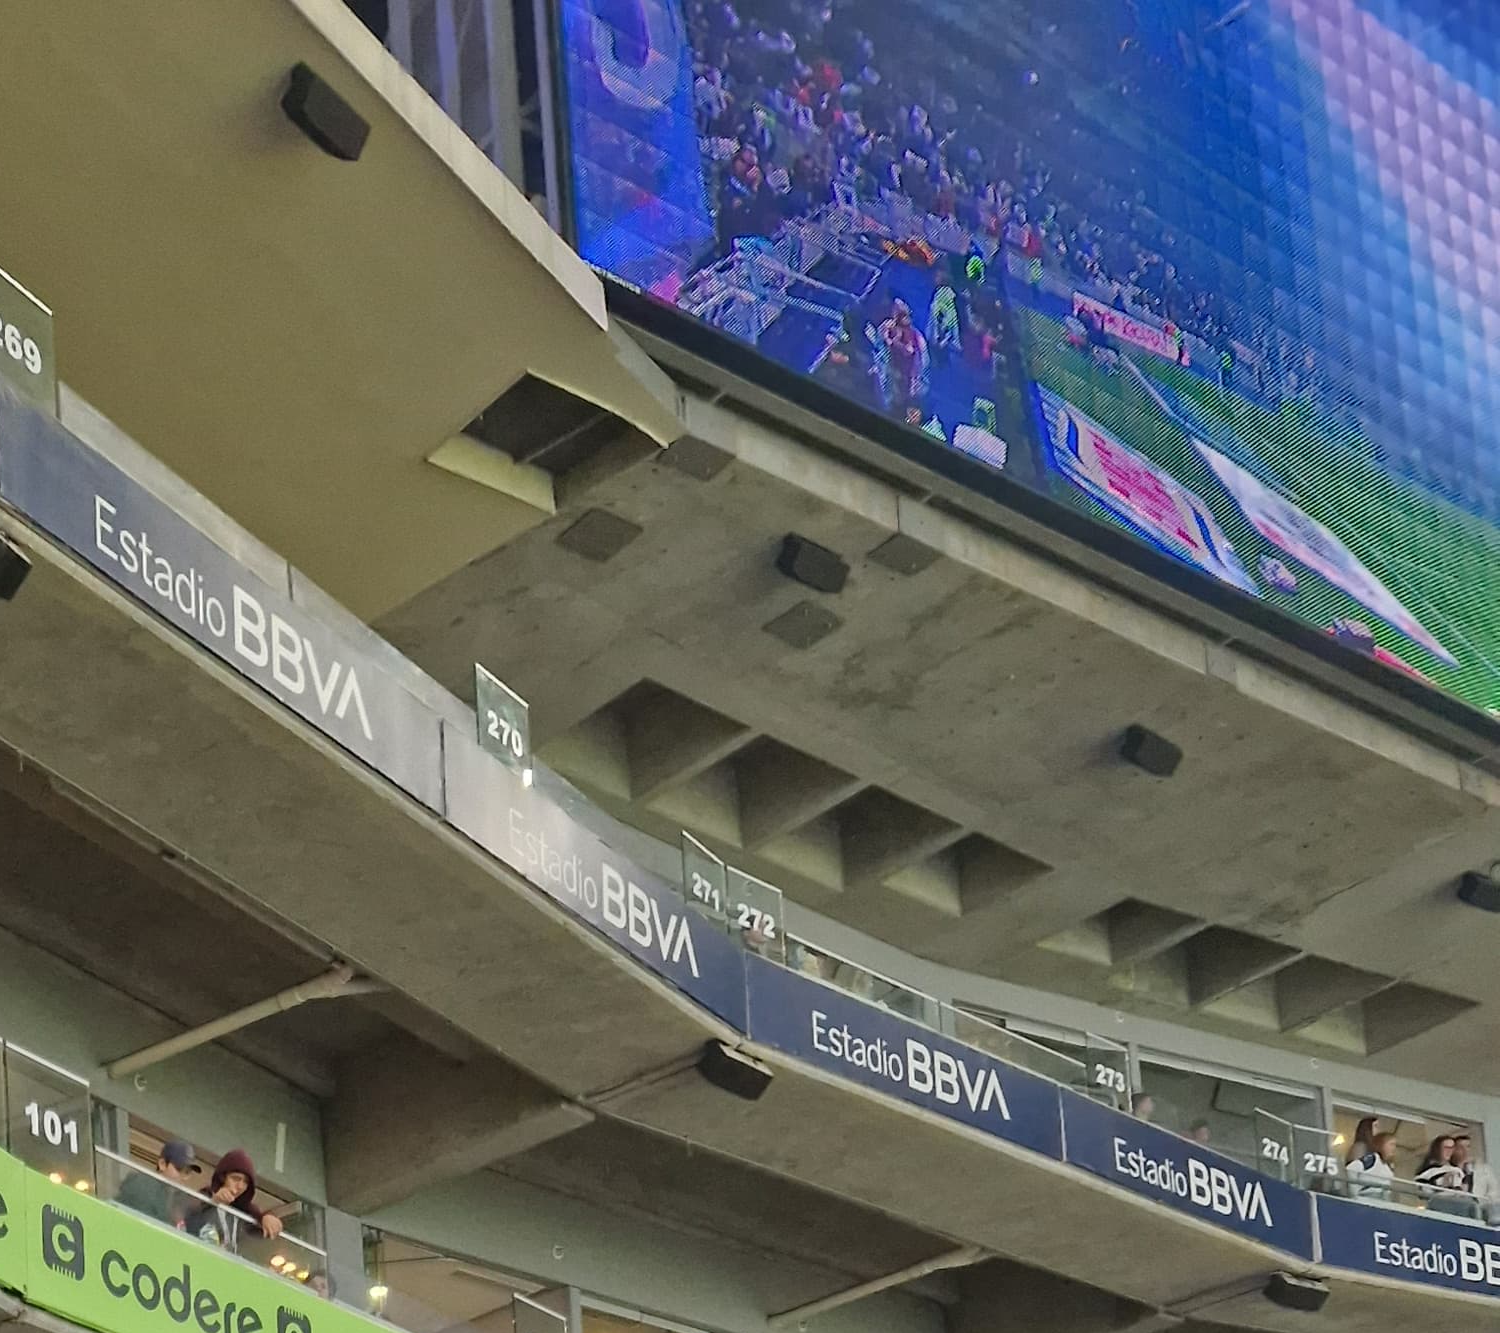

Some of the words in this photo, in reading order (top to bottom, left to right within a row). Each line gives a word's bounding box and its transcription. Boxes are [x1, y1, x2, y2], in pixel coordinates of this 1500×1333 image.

[95, 494, 226, 637] Estadio
[233, 584, 373, 740] BBVA
[486, 710, 524, 757] 270
[508, 807, 597, 909] Estadio
[602, 862, 700, 977] BBVA
[691, 871, 720, 913] 271
[736, 902, 776, 939] 272
[811, 1009, 903, 1082] Estadio
[906, 1038, 1012, 1121] BBVA
[1094, 1063, 1126, 1093] 273
[24, 1102, 80, 1154] 101
[1260, 1137, 1290, 1166] 274
[1113, 1137, 1188, 1197] Estadio
[1187, 1158, 1273, 1228] BBVA
[1303, 1153, 1339, 1177] 275
[1373, 1231, 1458, 1278] Estadio
